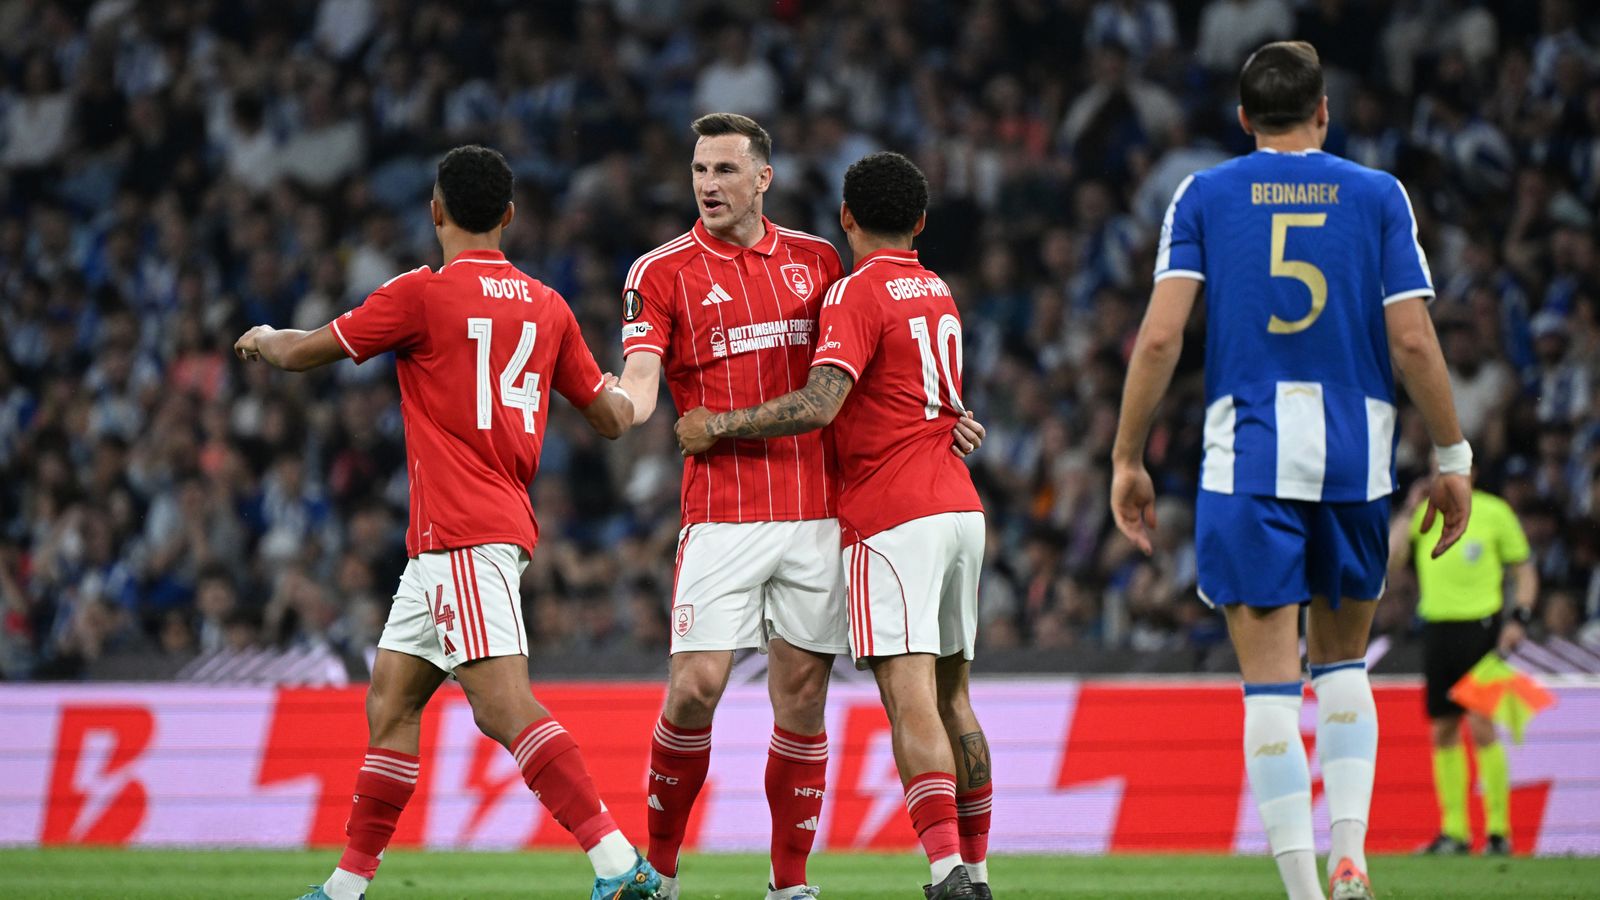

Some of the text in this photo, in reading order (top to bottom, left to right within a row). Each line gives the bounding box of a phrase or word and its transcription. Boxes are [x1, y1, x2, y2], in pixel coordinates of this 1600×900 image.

[1252, 183, 1340, 205] BEDNAREK
[1267, 213, 1328, 334] 5
[479, 276, 533, 303] NDOYE
[727, 320, 789, 342] NOTTINGHAM
[730, 333, 785, 354] COMMUNITY
[467, 317, 541, 434] 14
[908, 313, 969, 421] 10
